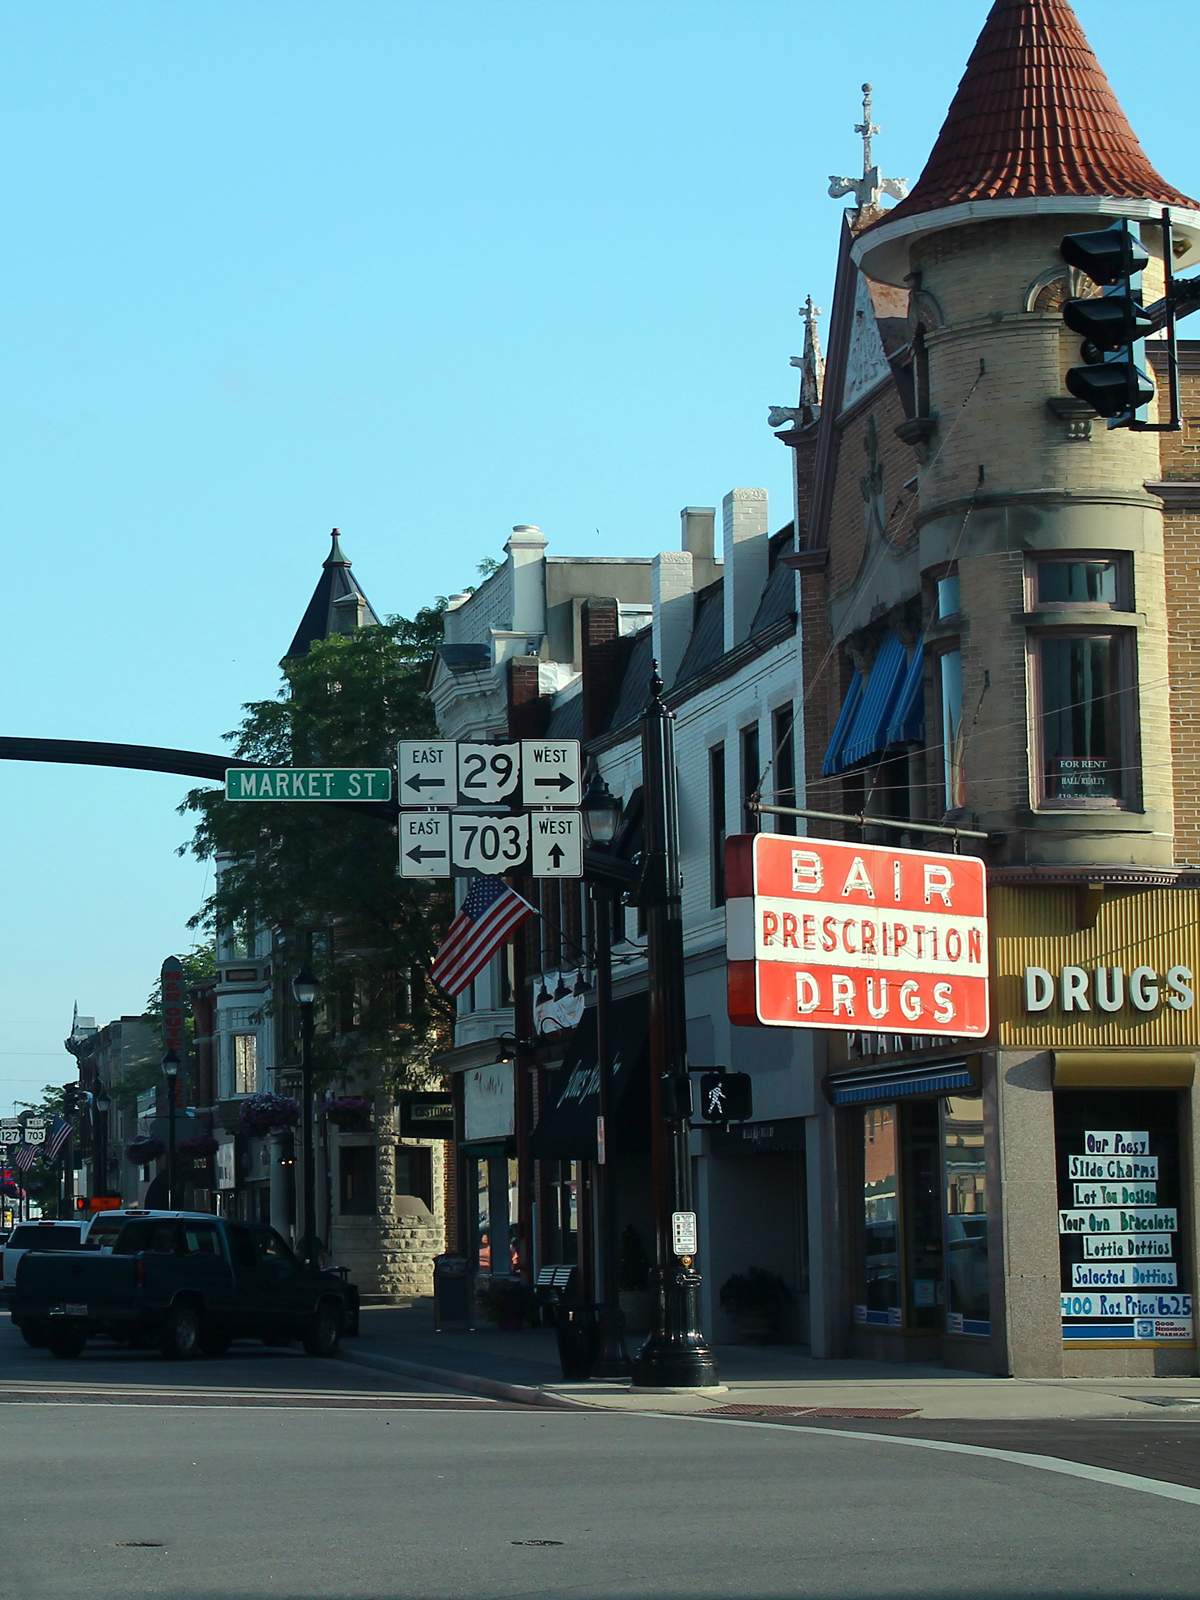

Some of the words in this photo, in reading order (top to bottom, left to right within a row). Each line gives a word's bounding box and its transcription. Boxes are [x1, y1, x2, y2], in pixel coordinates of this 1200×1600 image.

[412, 750, 444, 764] EAST
[533, 749, 567, 763] WEST
[1060, 760, 1079, 768] FOR
[1081, 760, 1107, 768] RENT
[463, 753, 513, 788] 29
[240, 773, 334, 797] MARKET
[348, 773, 376, 797] ST
[409, 821, 441, 835] EAST
[539, 821, 572, 835] WEST
[459, 825, 522, 860] 703
[791, 849, 955, 907] BAIR
[763, 910, 982, 964] PRESCRIPTION
[795, 971, 956, 1023] DRUGS
[1025, 965, 1195, 1012] DRUGS
[1, 1131, 18, 1141] 127
[27, 1131, 44, 1140] 703
[1086, 1133, 1108, 1153] Our
[1070, 1157, 1104, 1177] Slide
[1107, 1160, 1156, 1179] Charms
[1075, 1185, 1097, 1205] Let
[1100, 1185, 1118, 1204] You
[1122, 1186, 1157, 1205] Design
[1061, 1213, 1086, 1231] Your
[1089, 1212, 1110, 1232] Own
[1120, 1211, 1175, 1231] Bracelets
[1085, 1237, 1124, 1256] Lottie
[1127, 1238, 1170, 1256] Dotties
[1074, 1265, 1125, 1285] Selected
[1132, 1266, 1174, 1285] Dotties
[1125, 1294, 1155, 1315] Price
